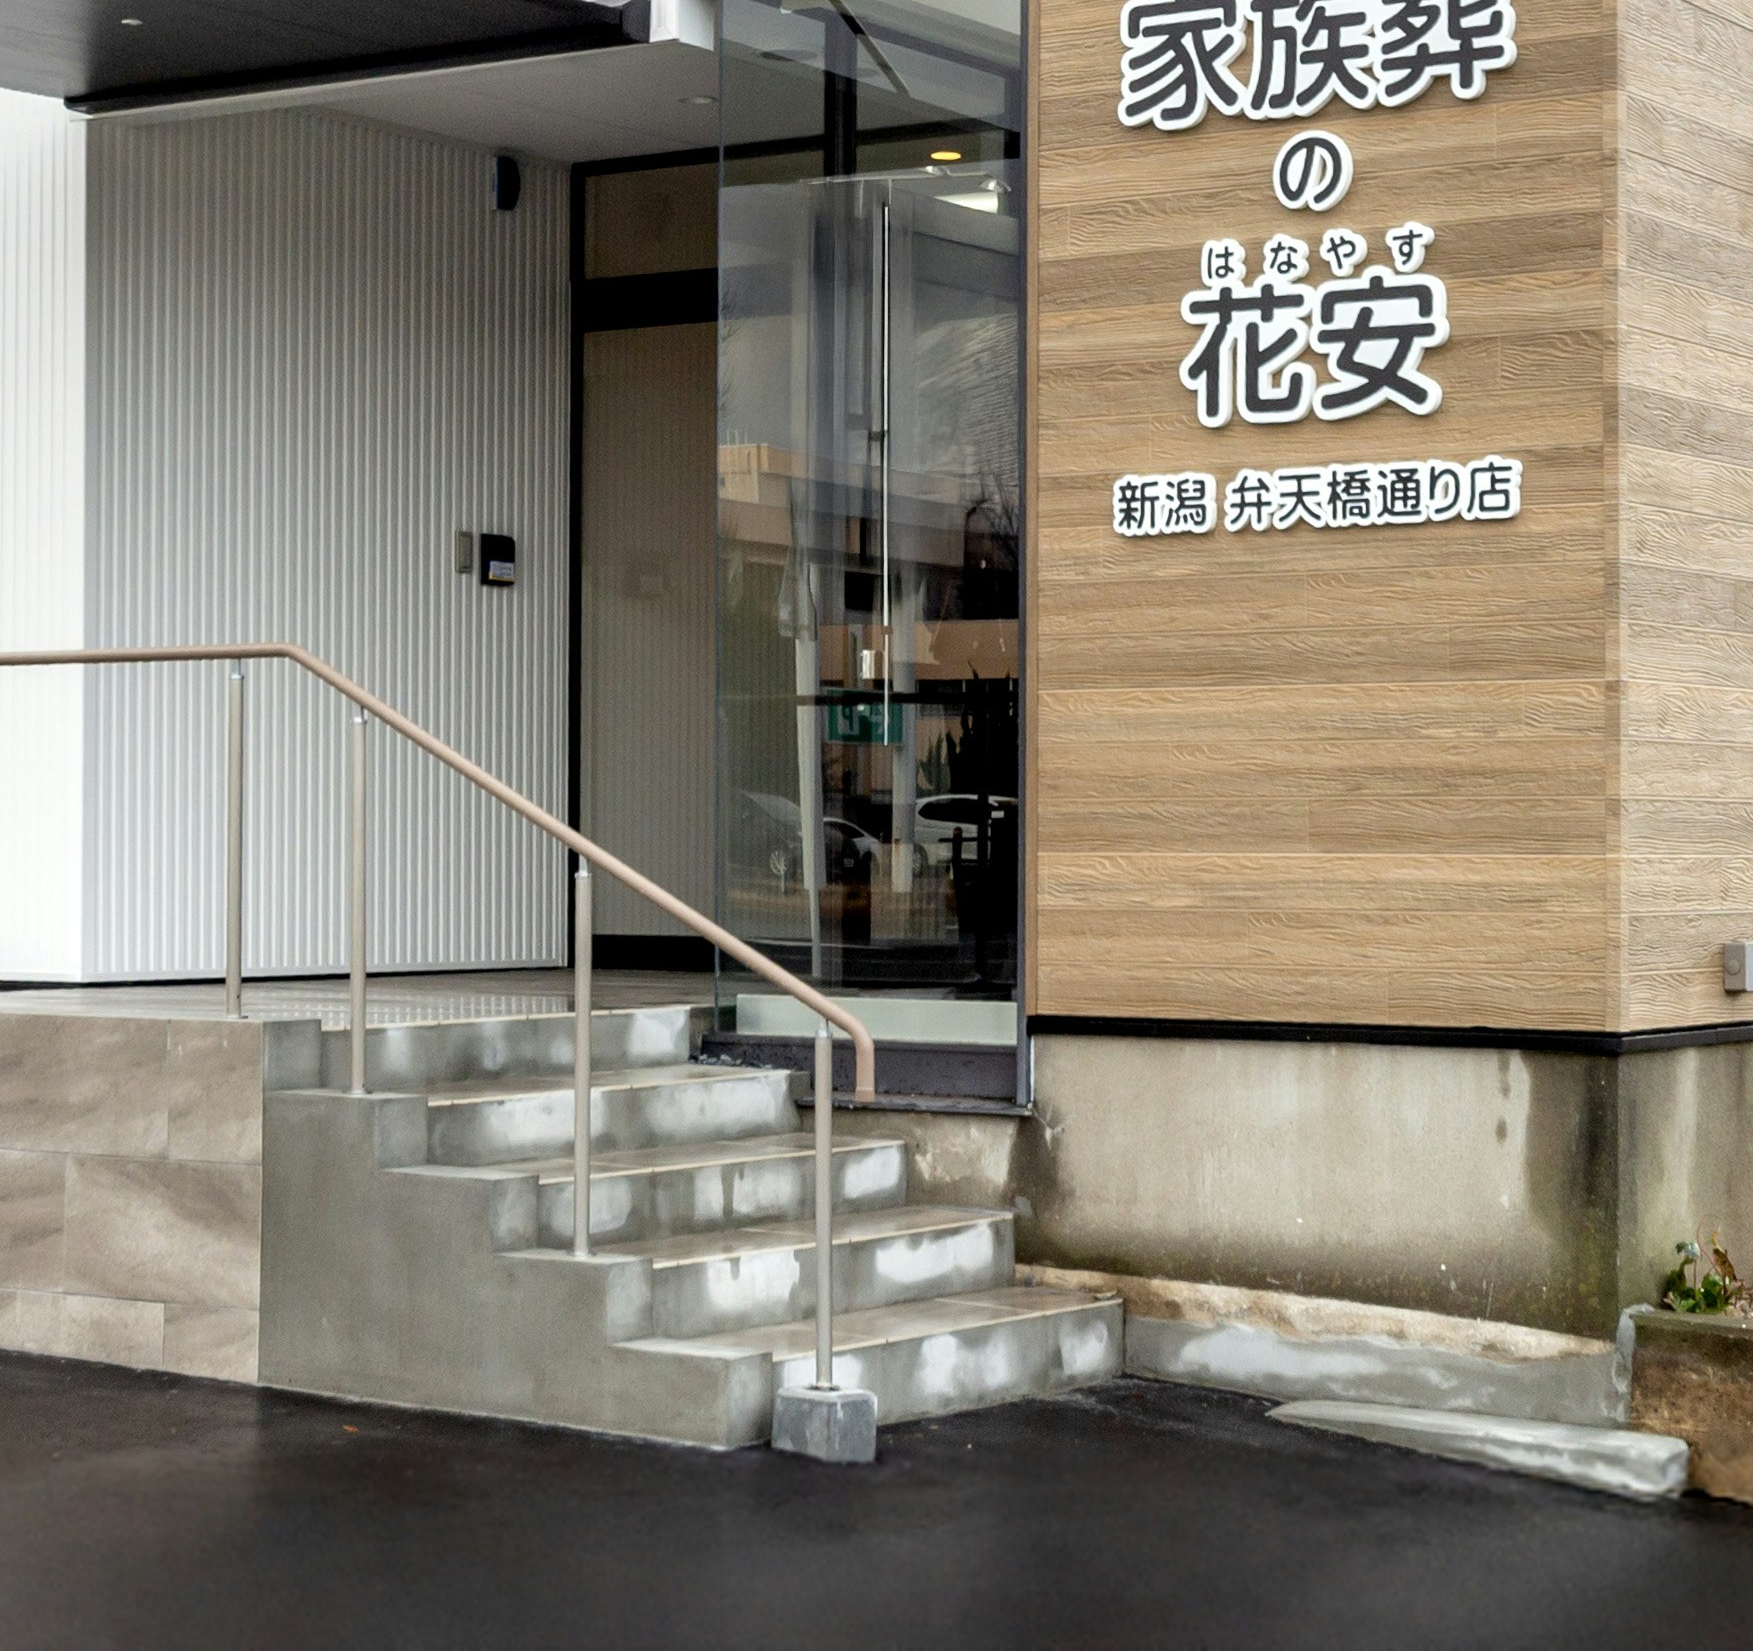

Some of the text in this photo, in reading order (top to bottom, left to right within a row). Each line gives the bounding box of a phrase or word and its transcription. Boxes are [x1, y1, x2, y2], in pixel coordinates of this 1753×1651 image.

[1279, 136, 1343, 204] の
[1206, 229, 1424, 279] はなやす
[1187, 275, 1437, 418] 花安
[1117, 461, 1514, 530] 新潟 弁天橋通り店
